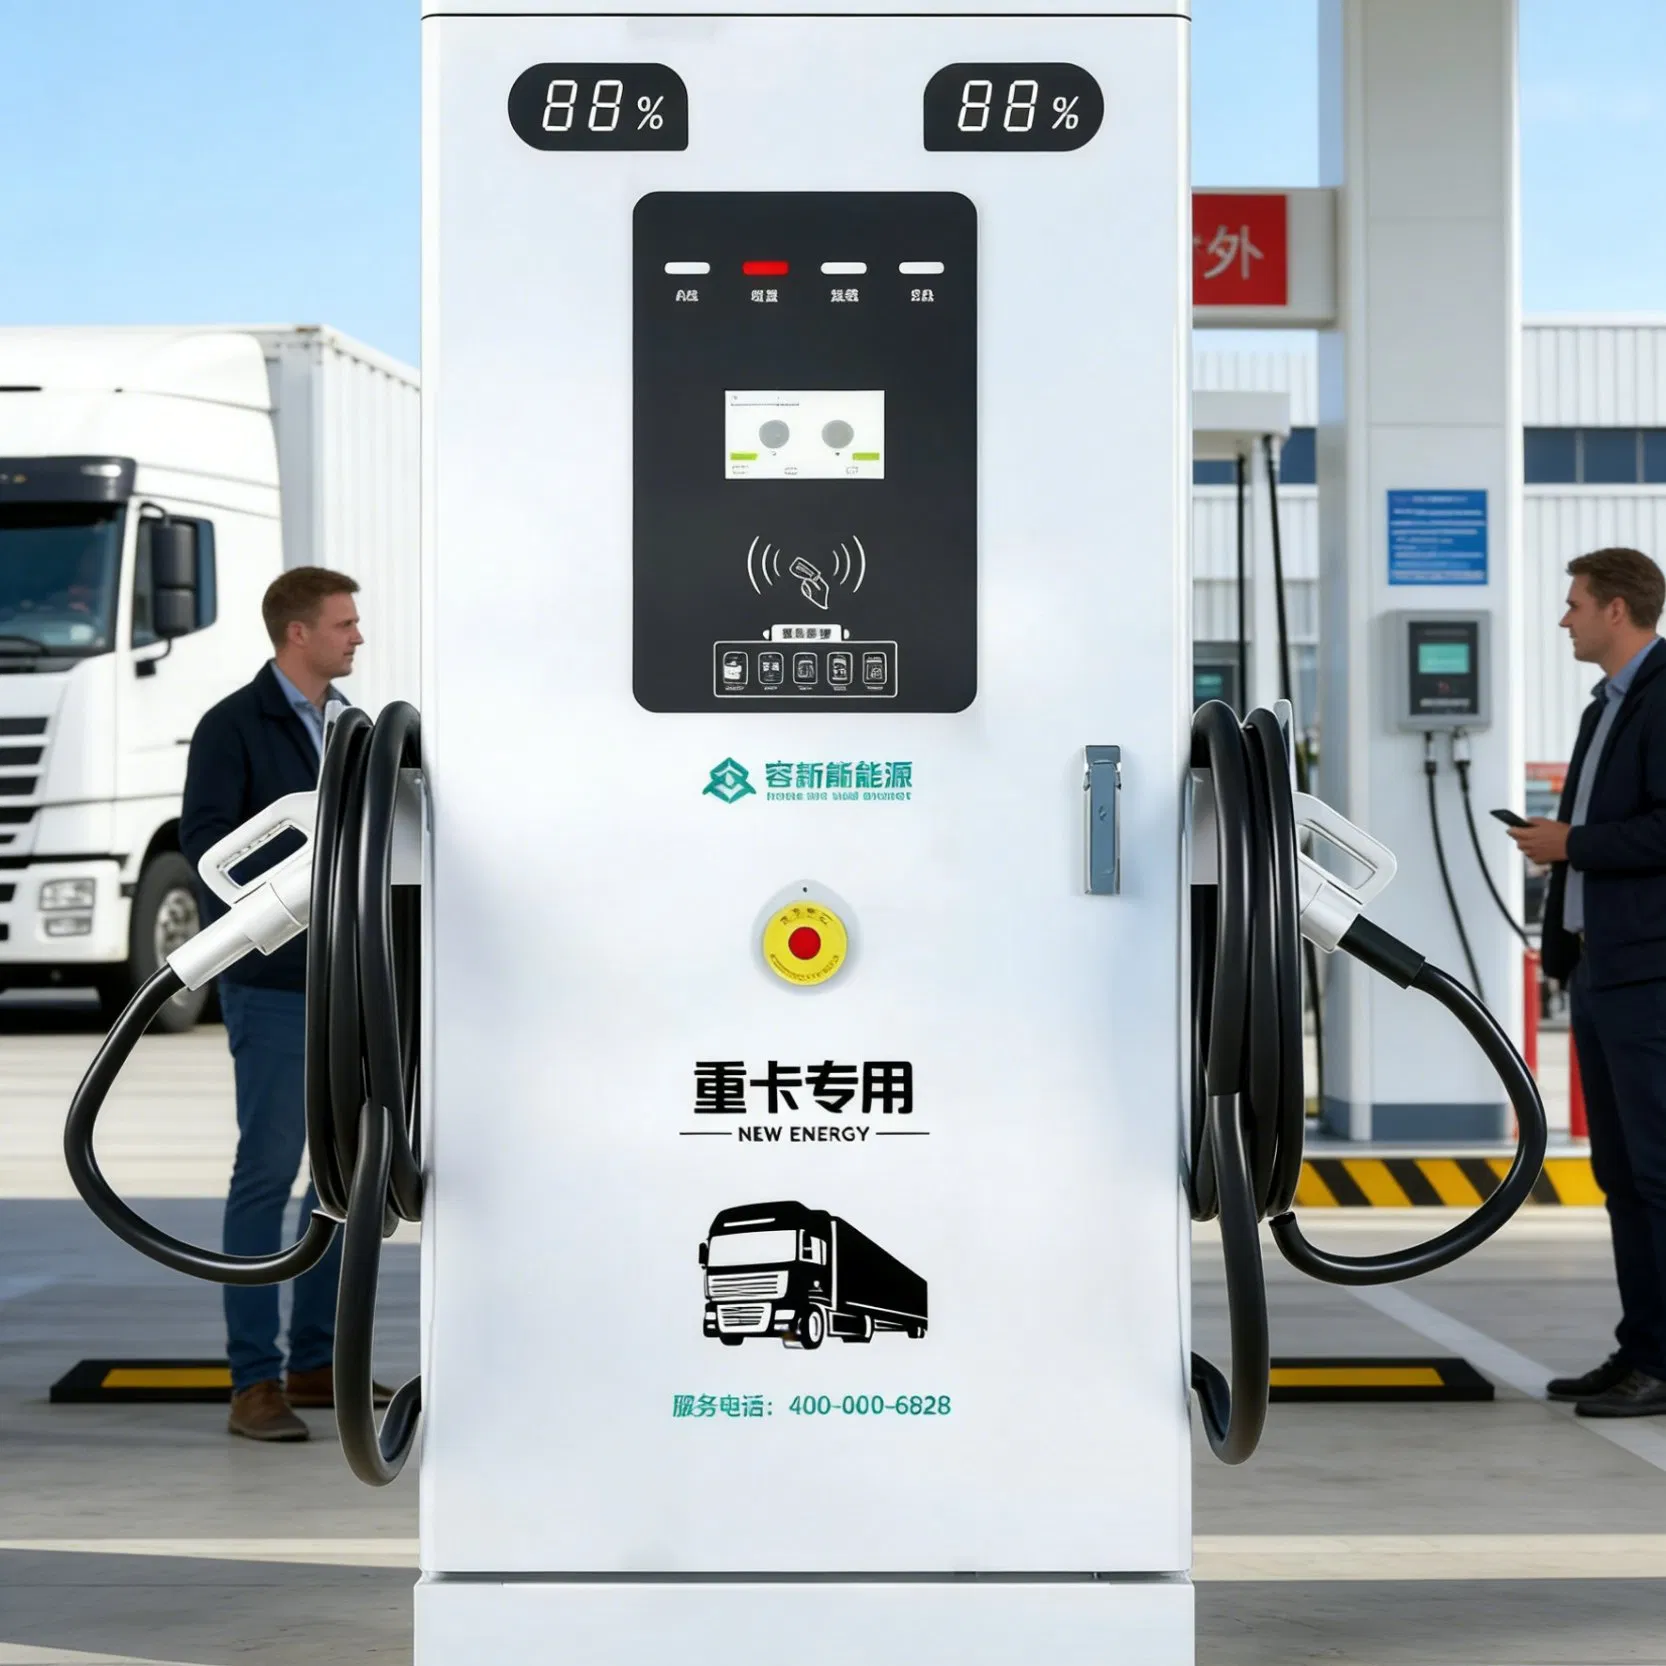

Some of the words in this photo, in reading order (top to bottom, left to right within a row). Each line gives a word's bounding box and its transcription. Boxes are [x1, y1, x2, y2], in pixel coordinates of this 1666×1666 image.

[1194, 225, 1264, 280] 外
[693, 1059, 914, 1115] 重卡专用
[738, 1125, 783, 1143] NEW
[789, 1125, 870, 1143] ENERGY
[788, 1394, 952, 1416] 400-000-6828
